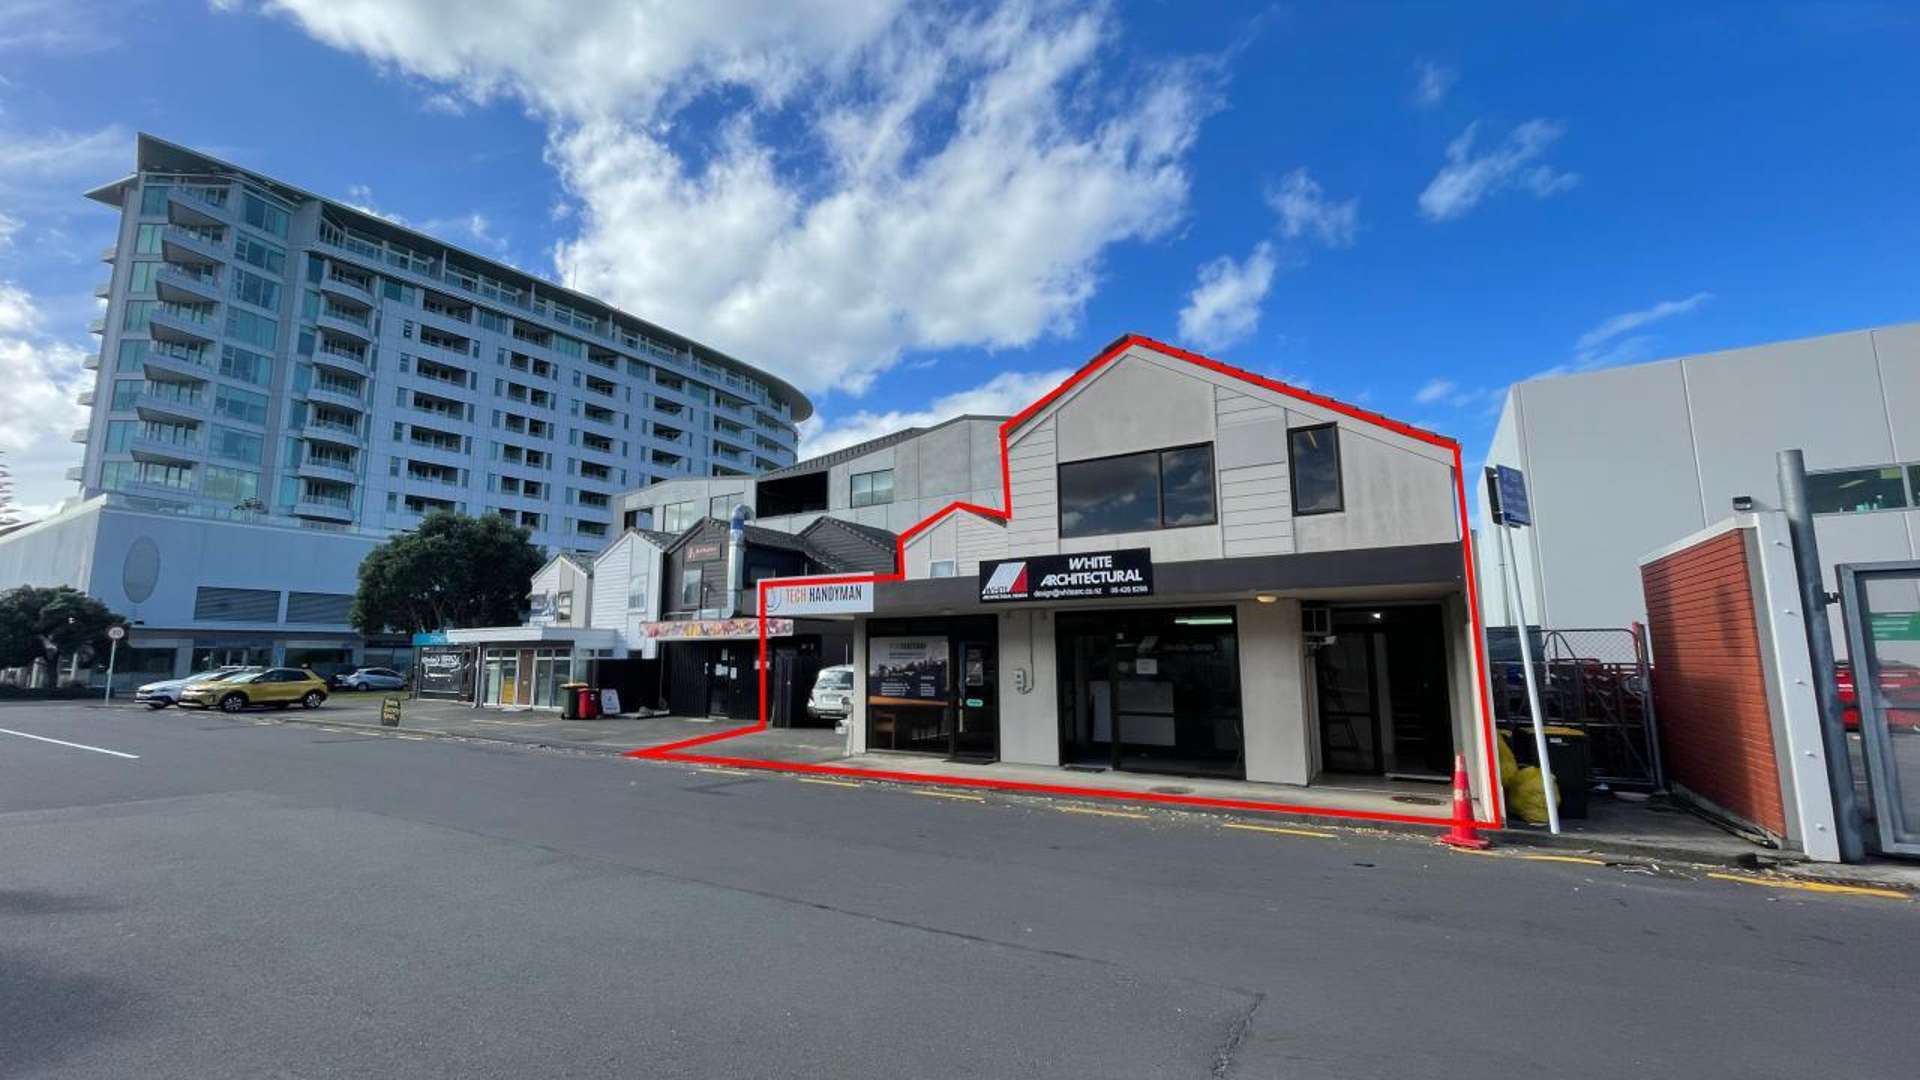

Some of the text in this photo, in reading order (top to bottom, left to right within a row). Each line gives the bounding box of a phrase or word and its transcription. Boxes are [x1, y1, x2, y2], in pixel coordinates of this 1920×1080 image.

[1068, 555, 1113, 571] WHITE
[1040, 569, 1143, 587] ARCHITECTURAL
[784, 584, 862, 603] TECH HANDYMAN
